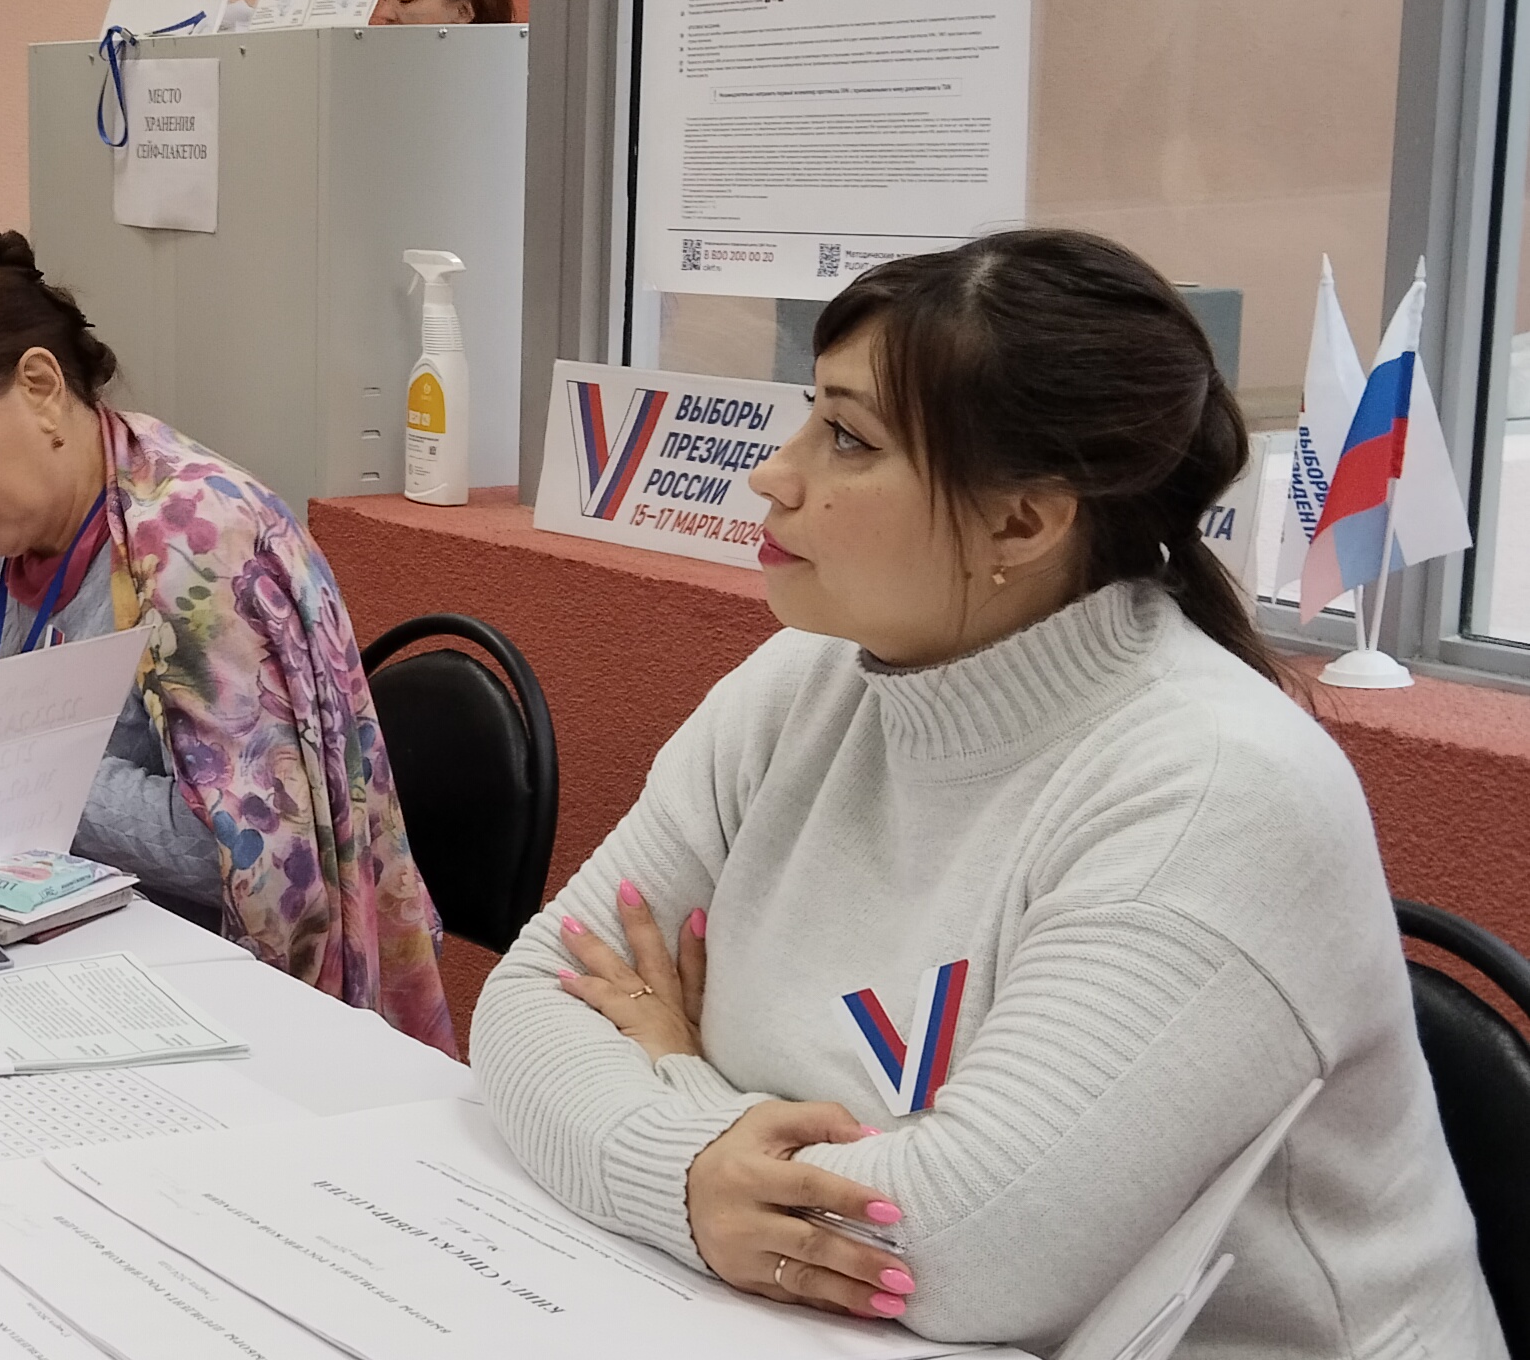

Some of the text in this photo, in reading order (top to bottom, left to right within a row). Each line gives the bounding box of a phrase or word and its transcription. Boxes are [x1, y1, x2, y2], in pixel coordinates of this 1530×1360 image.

[148, 87, 182, 104] МЕСТО
[144, 115, 196, 132] ХРАНЕНИЯ
[136, 141, 208, 161] СЕЙФ-ПАКЕТОВ
[675, 394, 774, 431] ВЫБОРЫ
[660, 432, 782, 472] ПРЕЗИДЕН
[643, 468, 731, 506] РОССИИ
[671, 510, 724, 540] МАРТА
[722, 519, 764, 547] 2024
[311, 1180, 437, 1246] ИЗБИРАТЕЛЕЙ
[429, 1236, 511, 1287] СПИСКА
[503, 1278, 565, 1315] КНИГА
